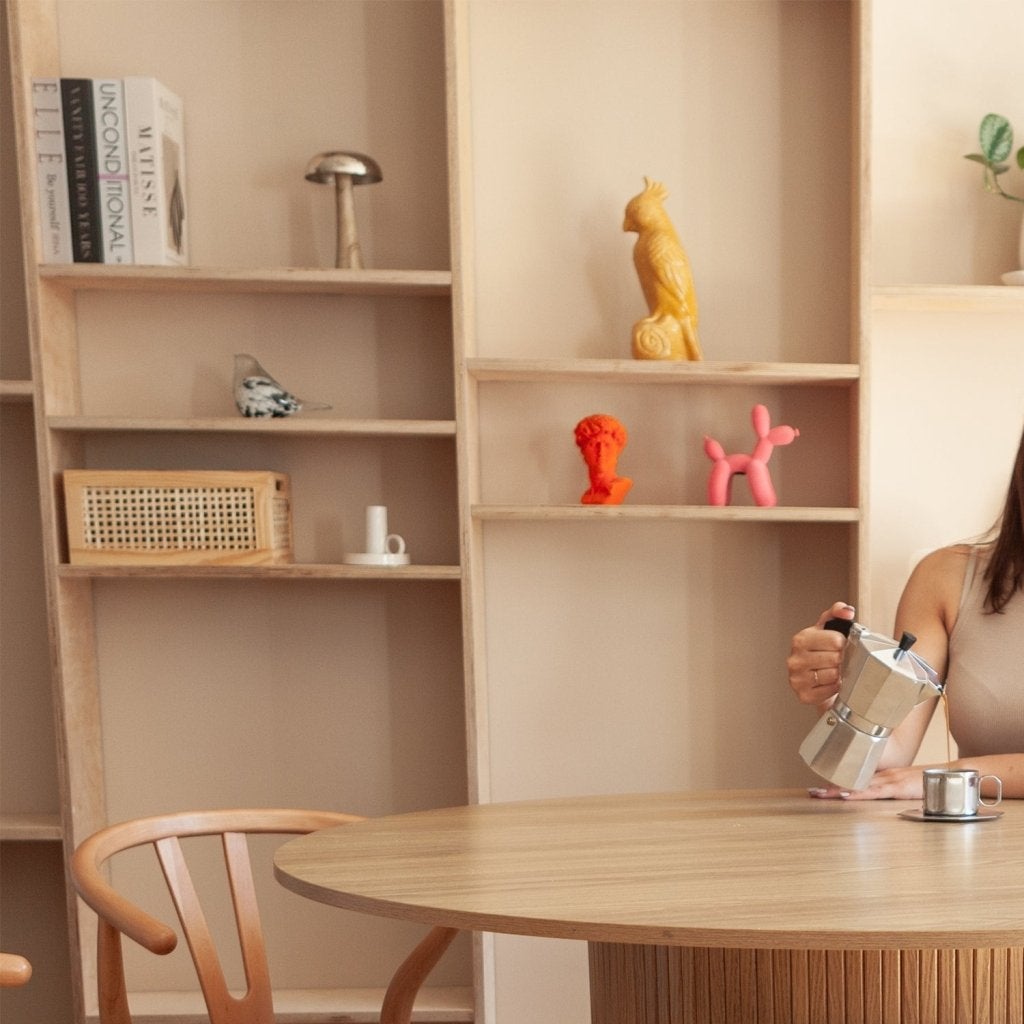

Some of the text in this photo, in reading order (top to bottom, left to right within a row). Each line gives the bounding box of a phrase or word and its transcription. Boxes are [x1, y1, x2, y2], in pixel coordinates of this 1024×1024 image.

[33, 82, 62, 164] ELLE
[99, 83, 125, 252] UNCONDITIONAL
[138, 125, 157, 217] MATISSE
